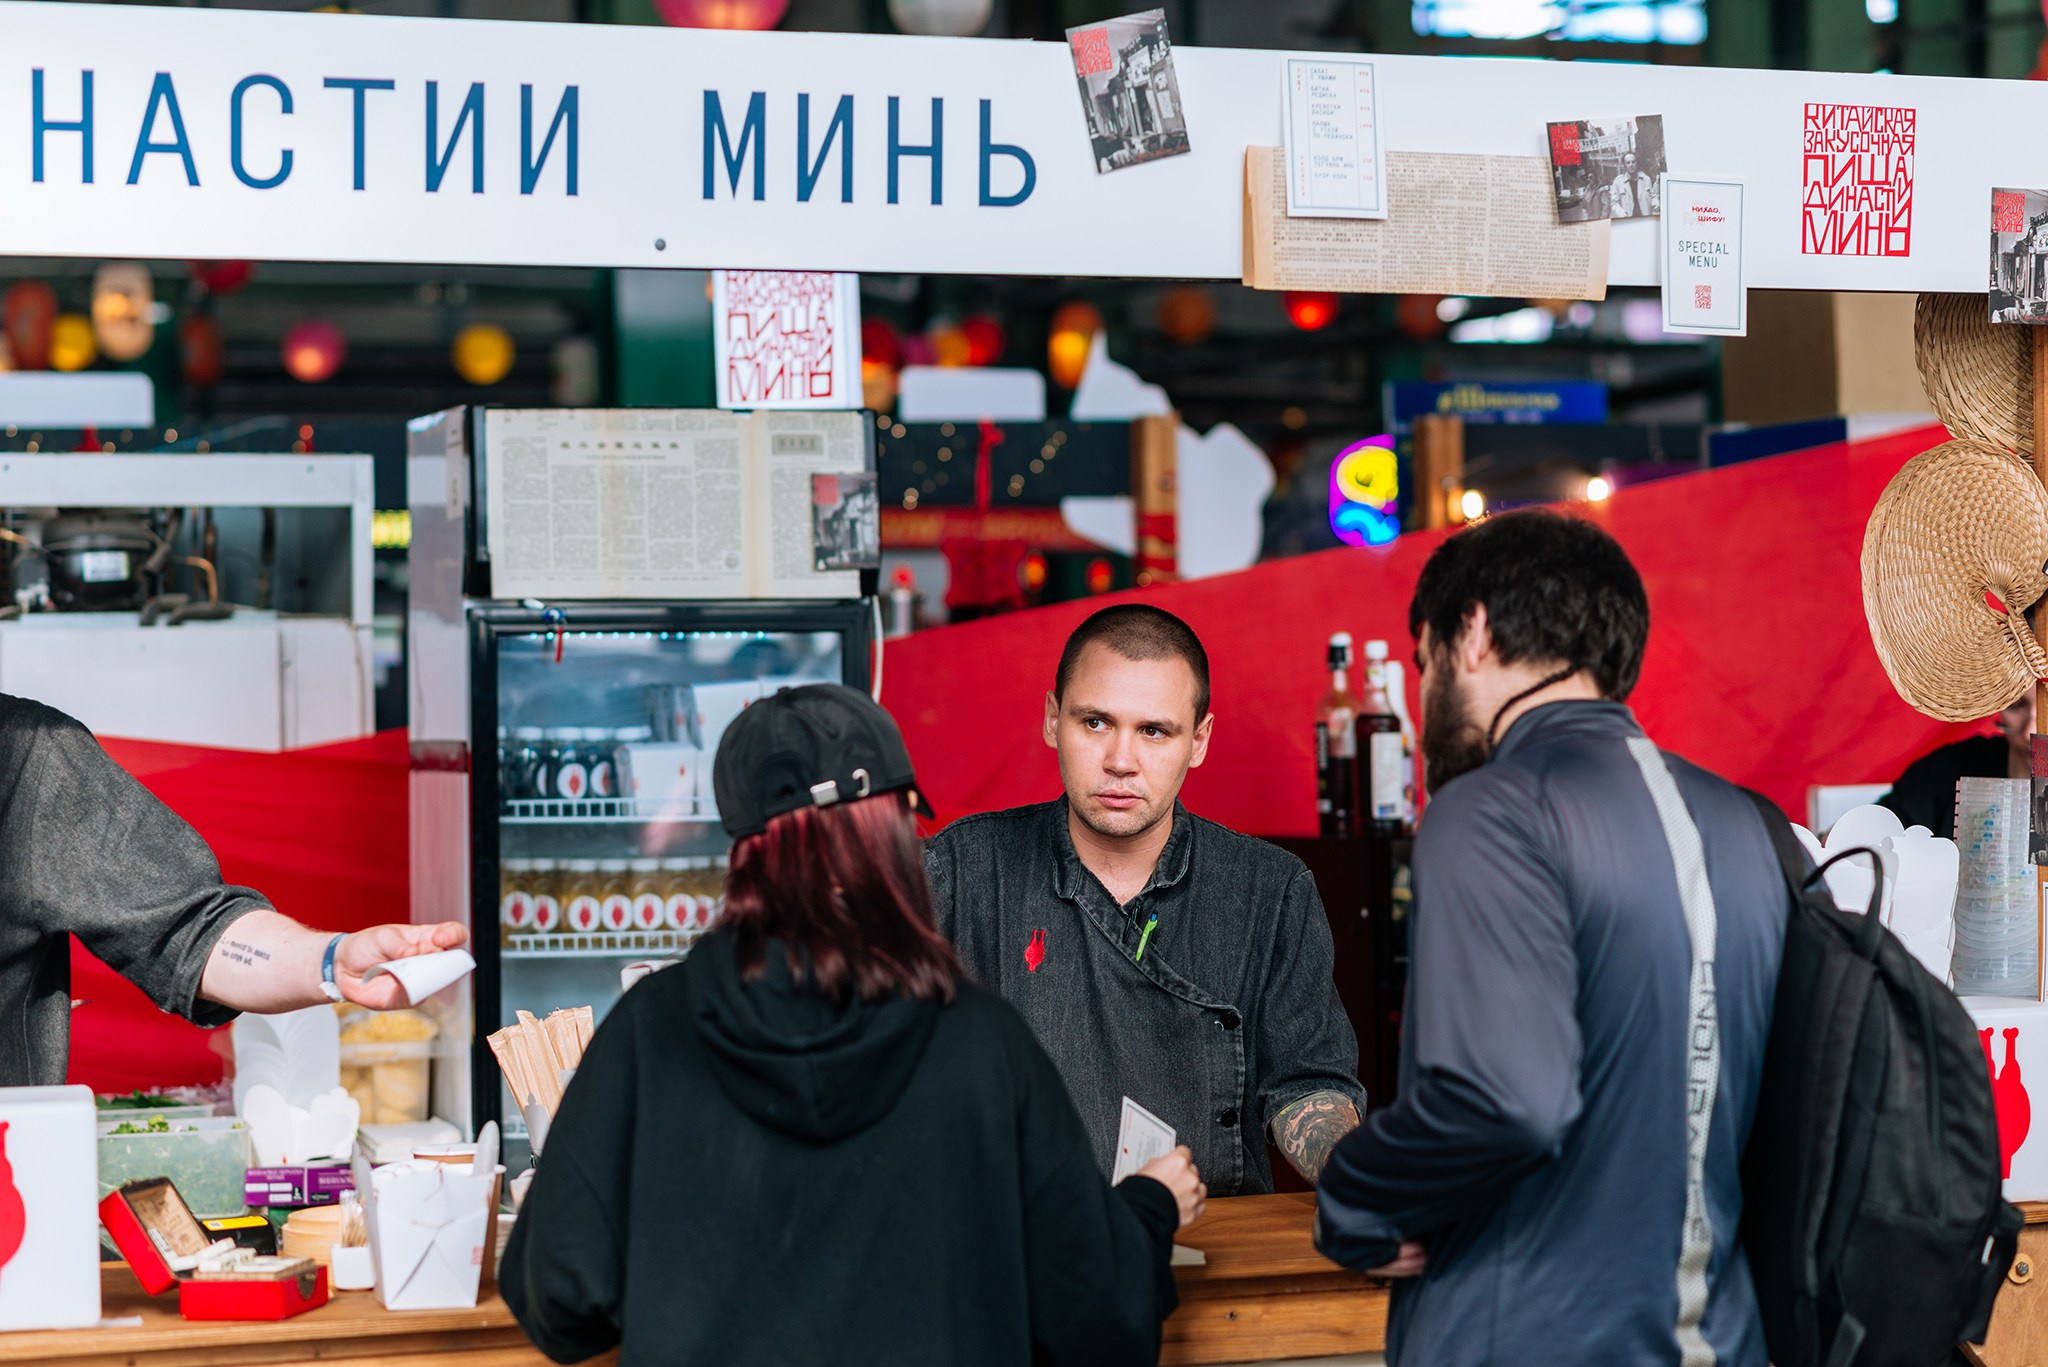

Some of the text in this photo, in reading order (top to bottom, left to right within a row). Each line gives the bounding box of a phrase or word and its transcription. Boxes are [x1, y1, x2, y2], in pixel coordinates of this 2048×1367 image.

[1804, 103, 1916, 134] КИТАЙСКАЯ
[31, 67, 1037, 207] НАСТИИ МИНЬ
[1804, 128, 1915, 156] ЗАКУСОЧНАЯ
[1804, 154, 1912, 188] ПИЩА
[1678, 240, 1729, 255] SPECIAL
[1802, 210, 1911, 257] МИНЬ
[1688, 255, 1718, 268] MENU
[728, 362, 833, 402] МИНЬ
